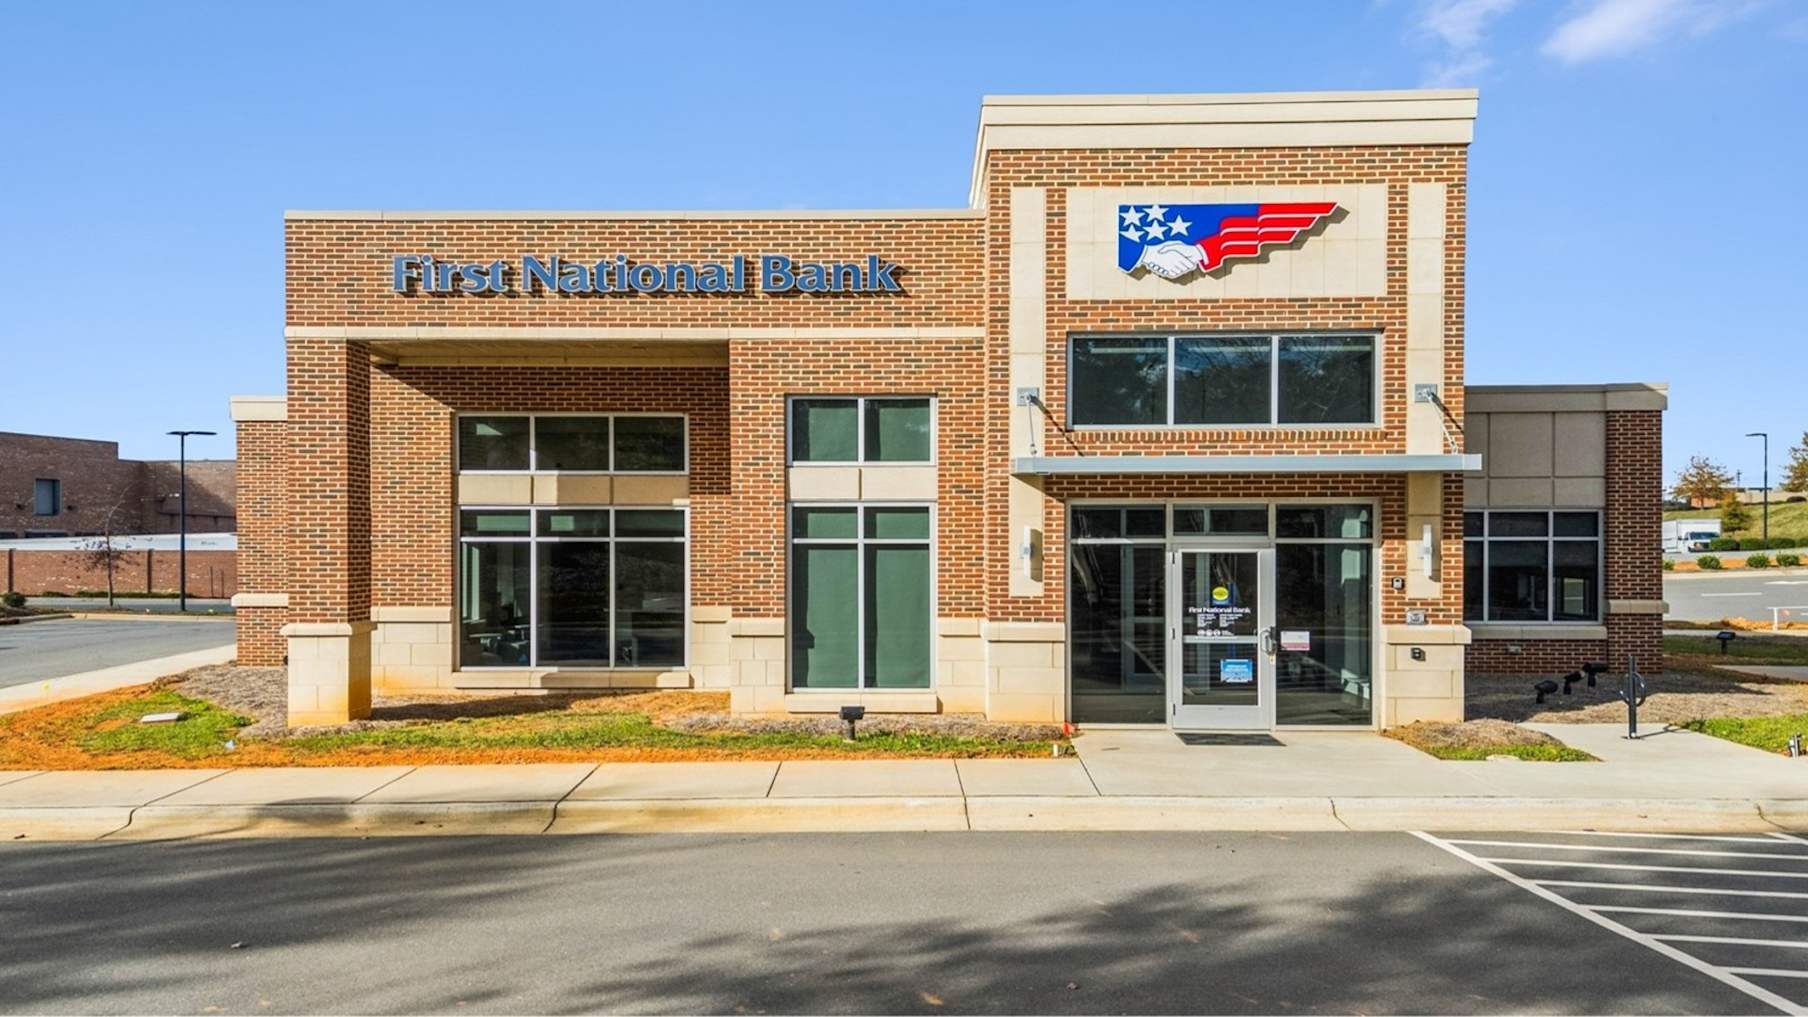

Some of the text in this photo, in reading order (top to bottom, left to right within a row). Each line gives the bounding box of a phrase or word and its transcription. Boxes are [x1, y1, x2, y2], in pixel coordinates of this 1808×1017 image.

[392, 254, 902, 293] First National Bank
